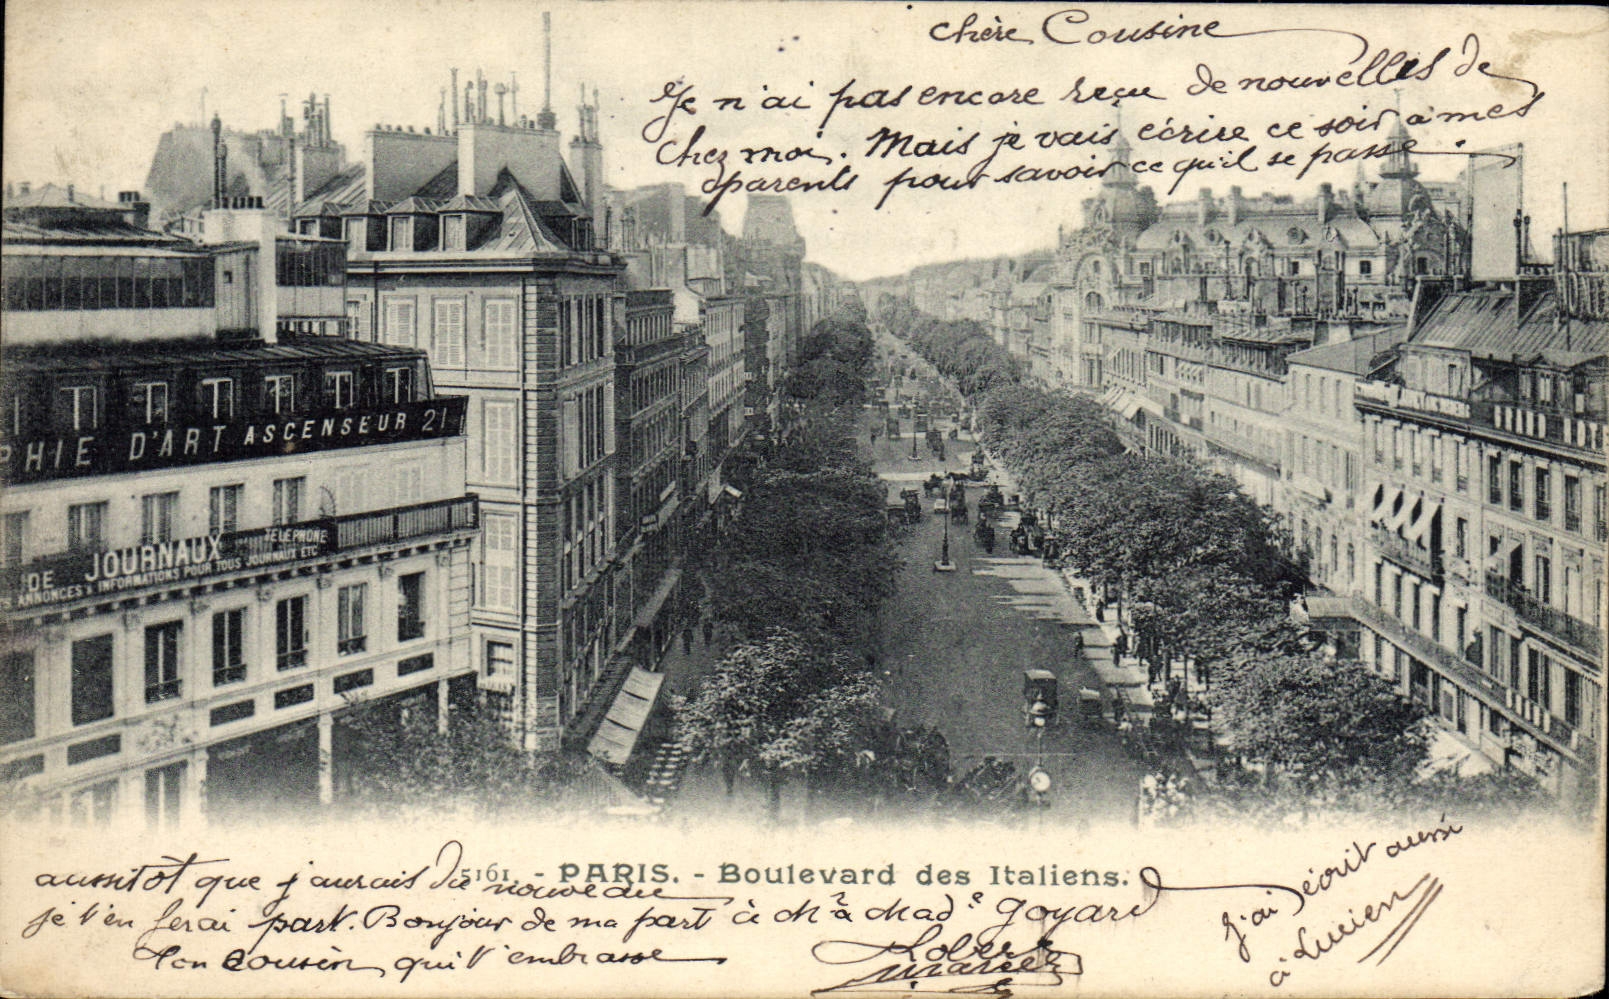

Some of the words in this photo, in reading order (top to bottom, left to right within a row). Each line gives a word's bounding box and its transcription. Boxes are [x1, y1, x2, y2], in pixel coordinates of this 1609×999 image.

[1042, 9, 1224, 45] Cousine
[642, 78, 697, 143] Je
[713, 80, 811, 111] n'ai
[819, 78, 913, 129] pas
[917, 86, 1045, 107] encore
[1059, 76, 1167, 108] reçu
[1187, 63, 1227, 96] de
[1238, 48, 1450, 92] nouvelles
[865, 126, 980, 158] Mais
[966, 121, 1026, 182] je
[1034, 123, 1119, 146] vais
[1137, 118, 1249, 144] écrire
[1266, 121, 1303, 141] ce
[1319, 105, 1400, 136] soir
[1440, 91, 1547, 124] mes
[702, 165, 859, 217] parents
[874, 166, 990, 210] pour
[994, 154, 1128, 183] savoir
[1131, 158, 1164, 174] ce
[1168, 145, 1258, 196] qu'il
[1267, 152, 1296, 168] se
[128, 425, 227, 462] D'ART
[244, 411, 407, 446] ASCENSEUR
[422, 407, 448, 433] 21
[27, 569, 54, 592] DE
[85, 532, 222, 582] JOURNAUX
[98, 566, 180, 593] INFORMATIONS
[184, 561, 212, 577] POUR
[217, 557, 242, 572] TOUS
[194, 875, 262, 909] que
[429, 840, 471, 890] du
[482, 881, 700, 902] nouveau
[1303, 841, 1376, 896] écrit
[1386, 813, 1463, 857] aussi
[21, 904, 76, 939] je
[135, 898, 231, 945] ferai
[363, 905, 513, 950] Bonjour
[521, 907, 556, 931] de
[568, 916, 618, 930] ma
[623, 906, 716, 943] part
[1294, 883, 1412, 960] Lucien
[394, 951, 461, 983] qui
